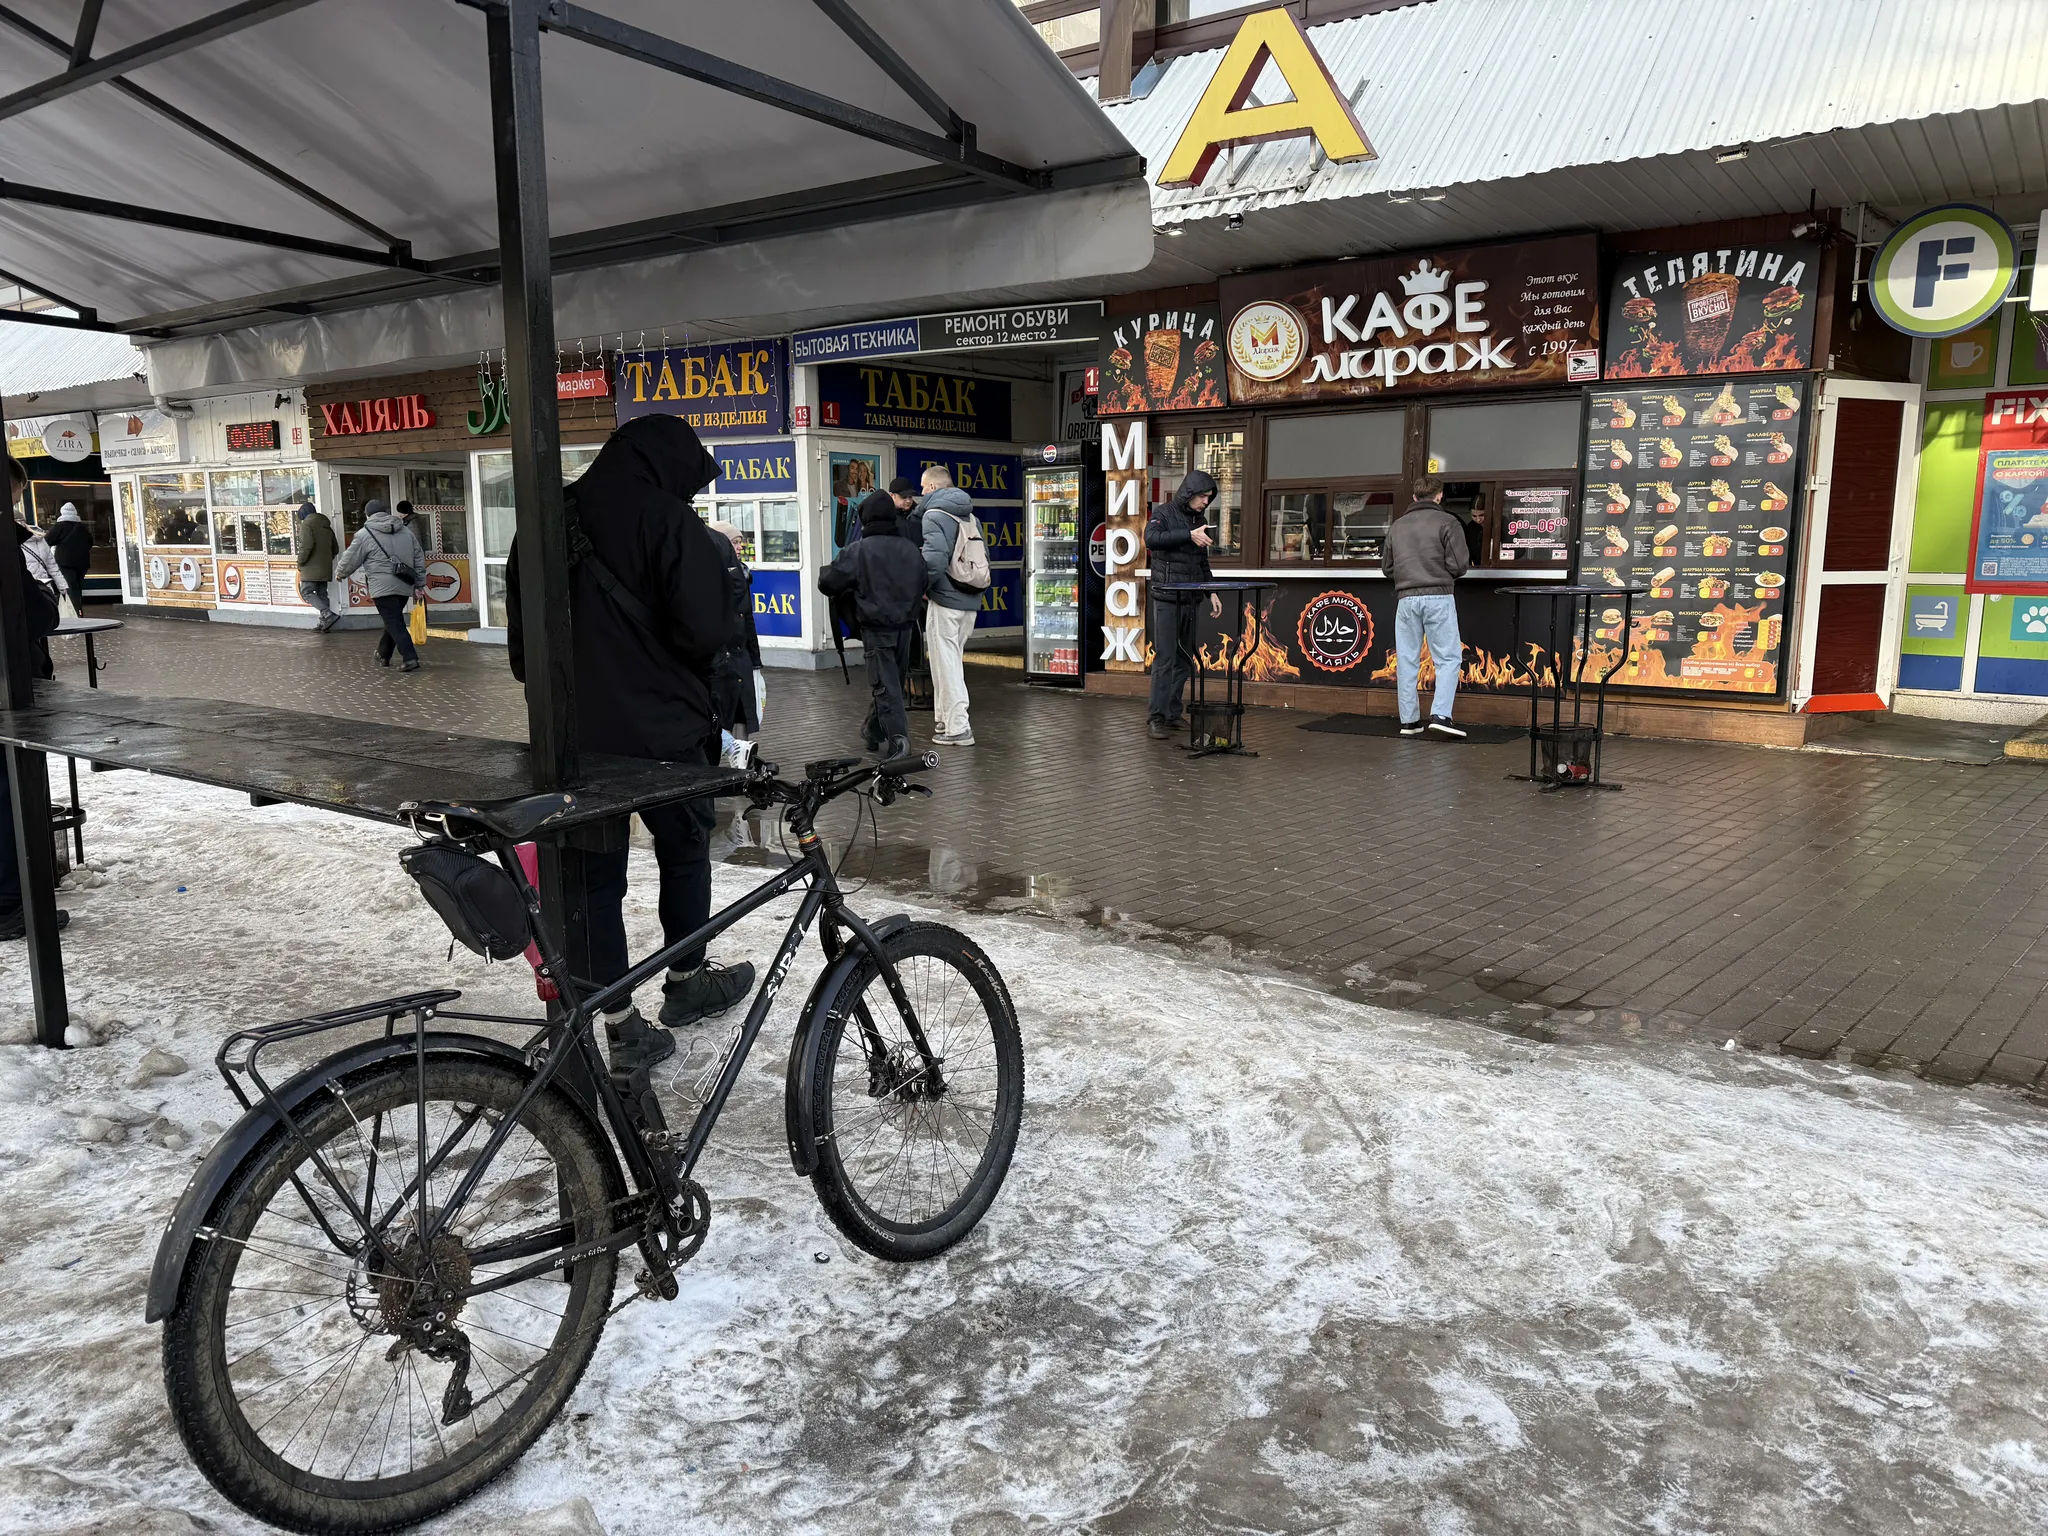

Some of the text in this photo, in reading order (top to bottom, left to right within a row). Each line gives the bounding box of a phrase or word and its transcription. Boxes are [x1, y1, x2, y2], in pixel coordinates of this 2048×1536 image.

[1526, 273, 1579, 286] Этот вкус
[1622, 250, 1806, 299] ТЕЛЯТИНА
[1520, 288, 1585, 302] Мы готовим
[1321, 281, 1490, 344] КАФЕ
[1534, 304, 1573, 316] для Вас
[1692, 301, 1726, 318] ВКУСНО
[945, 308, 1069, 334] РЕМОНТ ОБУВИ
[1113, 311, 1214, 348] КУРИЦА
[1522, 318, 1586, 334] каждый день
[795, 327, 916, 357] БЫТОВАЯ ТЕХНИКА
[956, 328, 1057, 346] сектор 12 место 2
[1541, 339, 1577, 356] 1997
[1302, 336, 1517, 388] мираж
[557, 378, 596, 394] маркет
[627, 350, 769, 402] ТАБАК
[1086, 369, 1099, 386] 1
[860, 367, 977, 417] ТАБАК
[320, 394, 433, 436] ХАЛЯЛЬ
[703, 410, 768, 429] ИЗДЕЛИЯ
[797, 408, 808, 420] 13
[827, 403, 834, 418] 1
[1991, 397, 2048, 425] FIX
[864, 412, 977, 434] ТАБАЧНЫЕ ИЗДЕЛИЯ
[57, 440, 83, 449] ZIRA
[721, 456, 791, 481] ТАБАК
[1997, 457, 2040, 467] ПЛАТИТЕ
[2004, 469, 2045, 478] КАРТОЙ!
[1100, 421, 1147, 663] Мираж
[753, 593, 796, 615] БАК
[1306, 597, 1366, 621] КАФЕ МИРАЖ
[1315, 615, 1355, 636] حلال
[1309, 648, 1360, 667] ХАЛЯЛЬ
